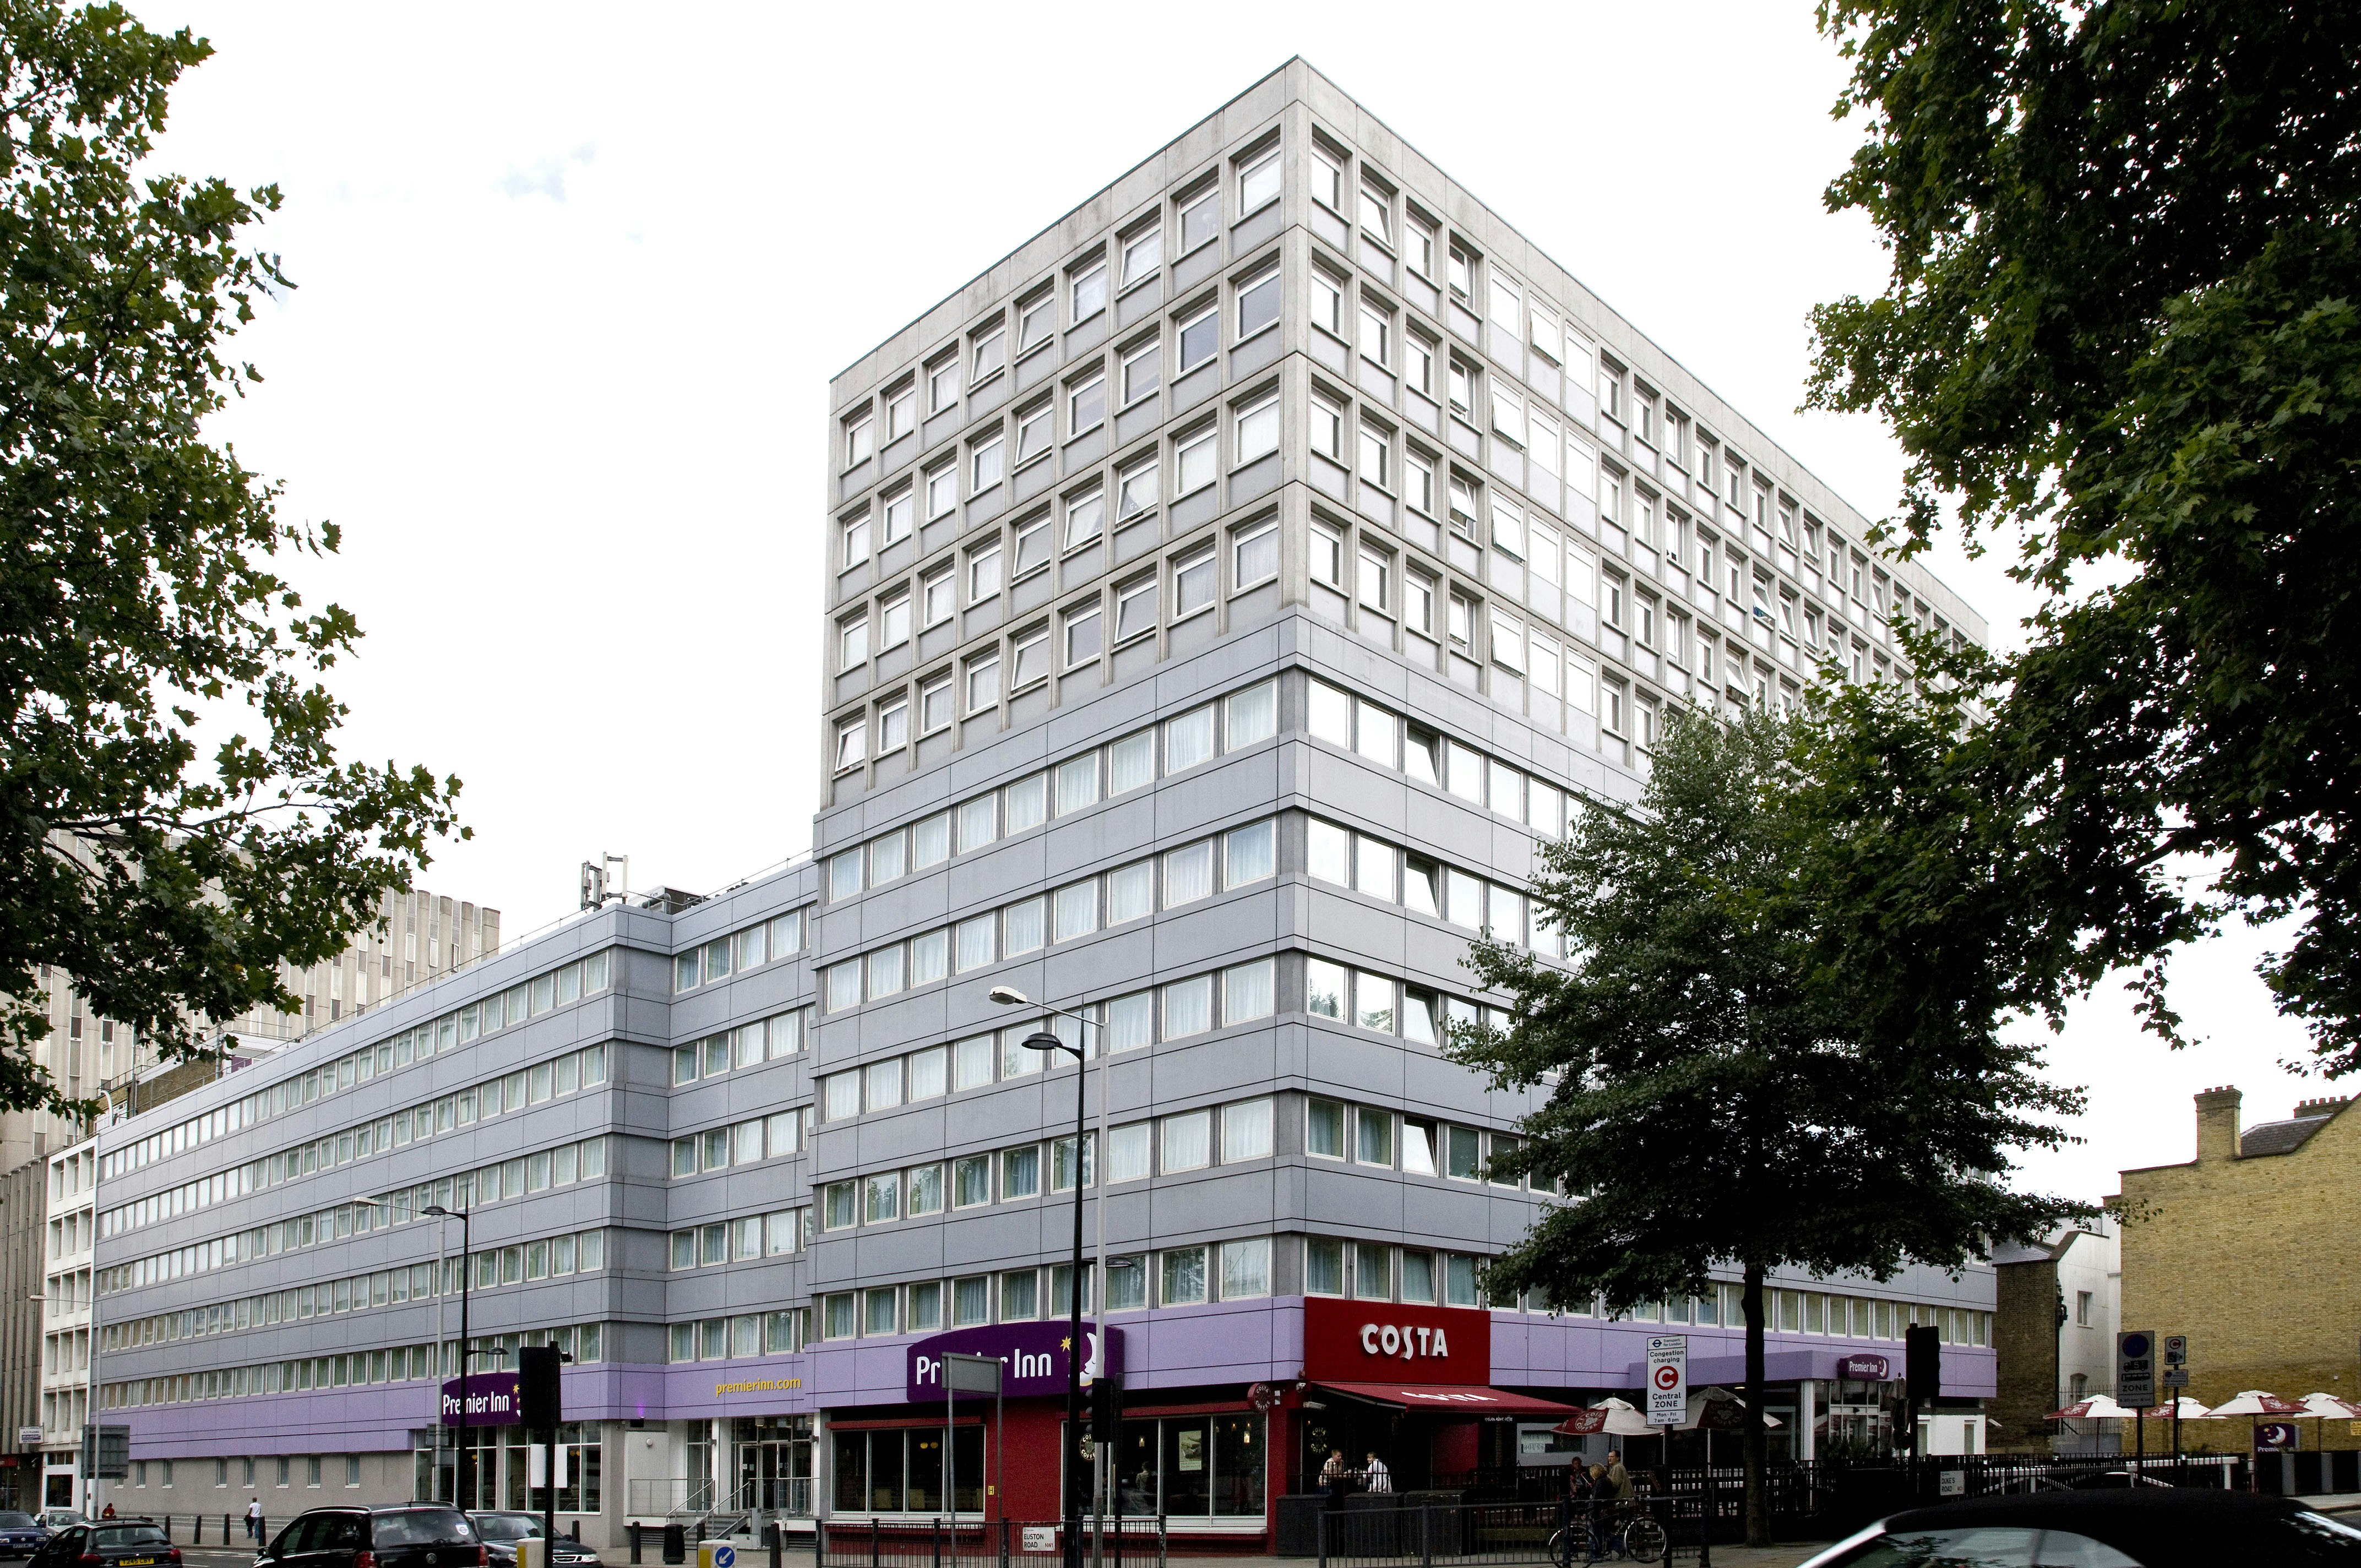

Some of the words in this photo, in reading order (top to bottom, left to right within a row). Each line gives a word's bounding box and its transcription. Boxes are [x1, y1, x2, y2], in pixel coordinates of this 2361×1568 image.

[1361, 1323, 1448, 1360] COSTA
[1014, 1348, 1052, 1378] Inn
[1849, 1360, 1869, 1372] Premier
[716, 1378, 801, 1398] premierinn.com
[1256, 1385, 1269, 1393] COSTA
[491, 1391, 509, 1412] Inn
[1082, 1434, 1092, 1442] COS
